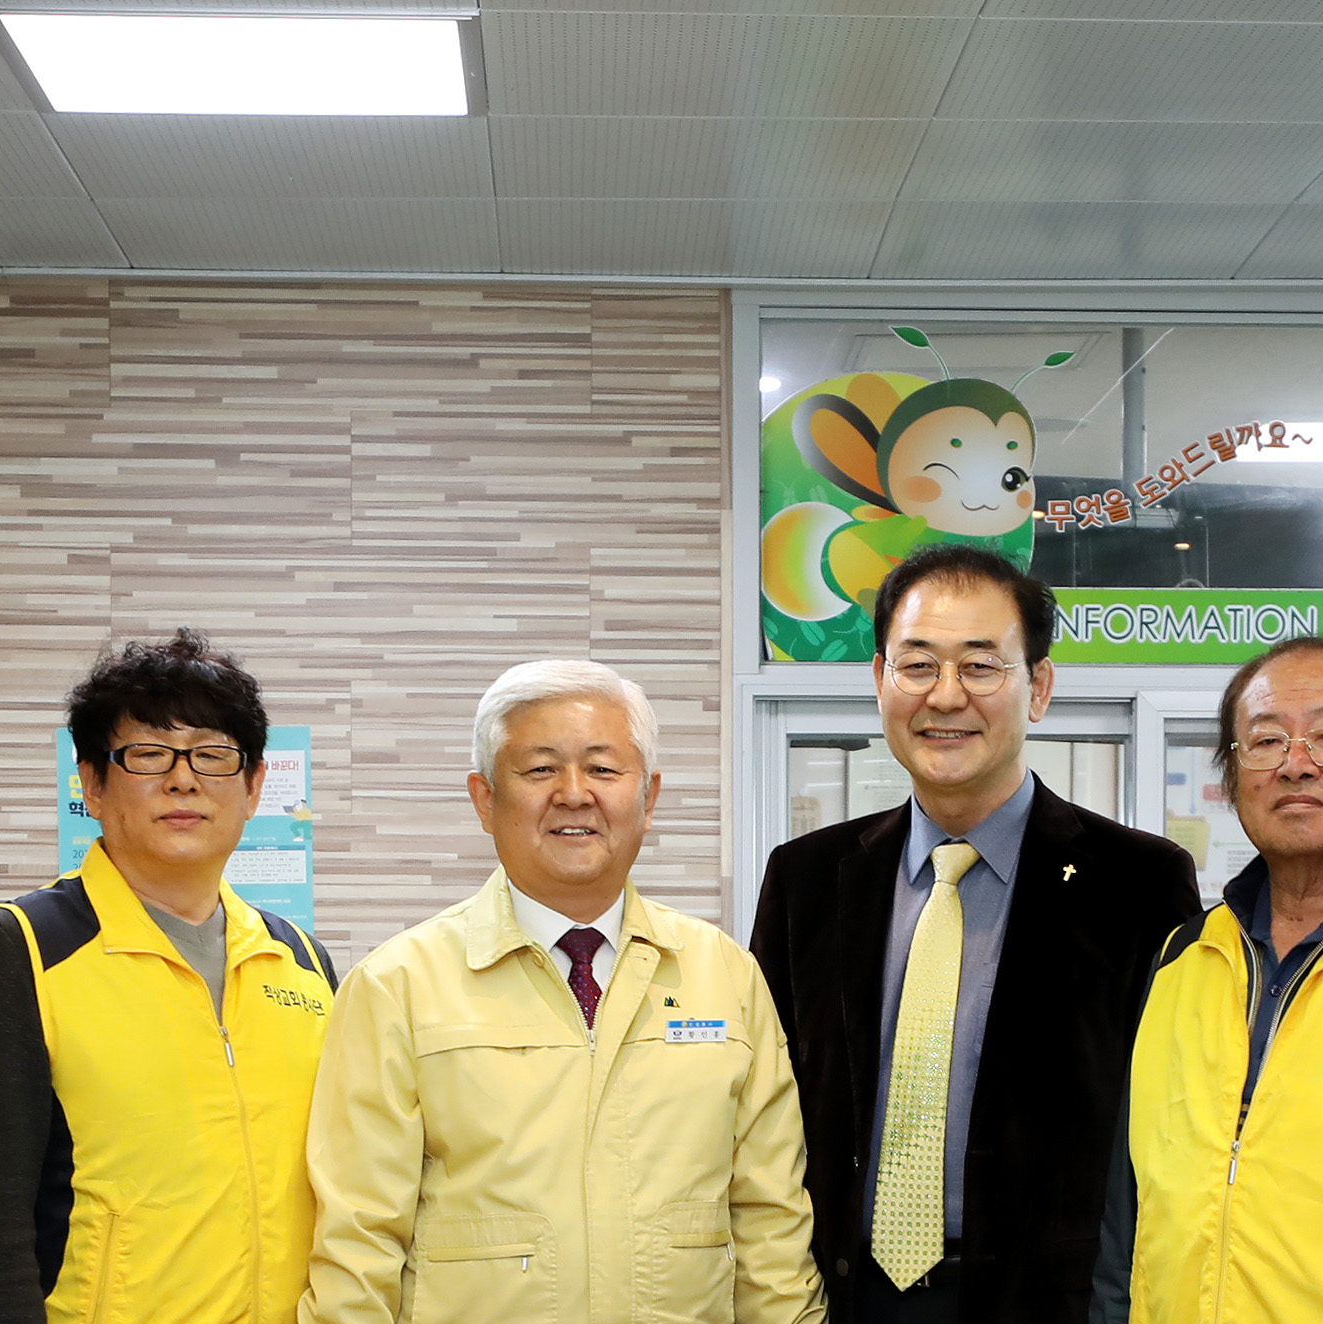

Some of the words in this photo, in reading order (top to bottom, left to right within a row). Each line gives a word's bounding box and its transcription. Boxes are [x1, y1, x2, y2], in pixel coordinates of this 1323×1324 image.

[1045, 490, 1131, 531] 무엇을
[1054, 605, 1317, 641] NFORMATION
[271, 760, 299, 771] 바꾼다!
